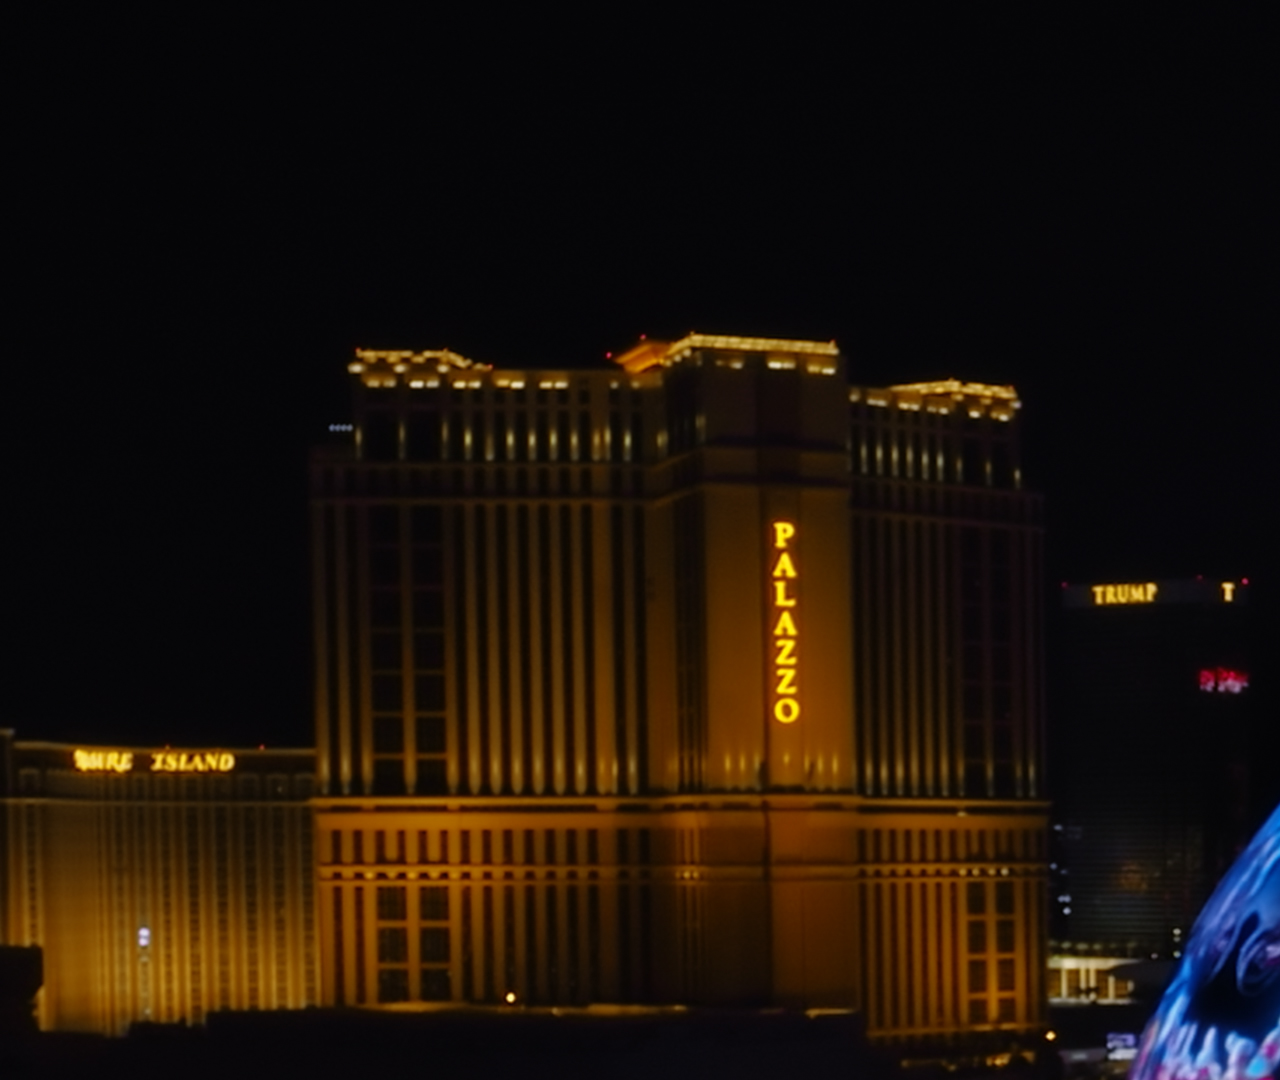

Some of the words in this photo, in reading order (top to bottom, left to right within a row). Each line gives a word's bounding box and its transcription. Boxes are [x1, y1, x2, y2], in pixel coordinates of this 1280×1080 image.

[1092, 582, 1158, 605] TRUMP
[773, 521, 800, 723] PALAZZO
[151, 752, 235, 772] ISLAND
